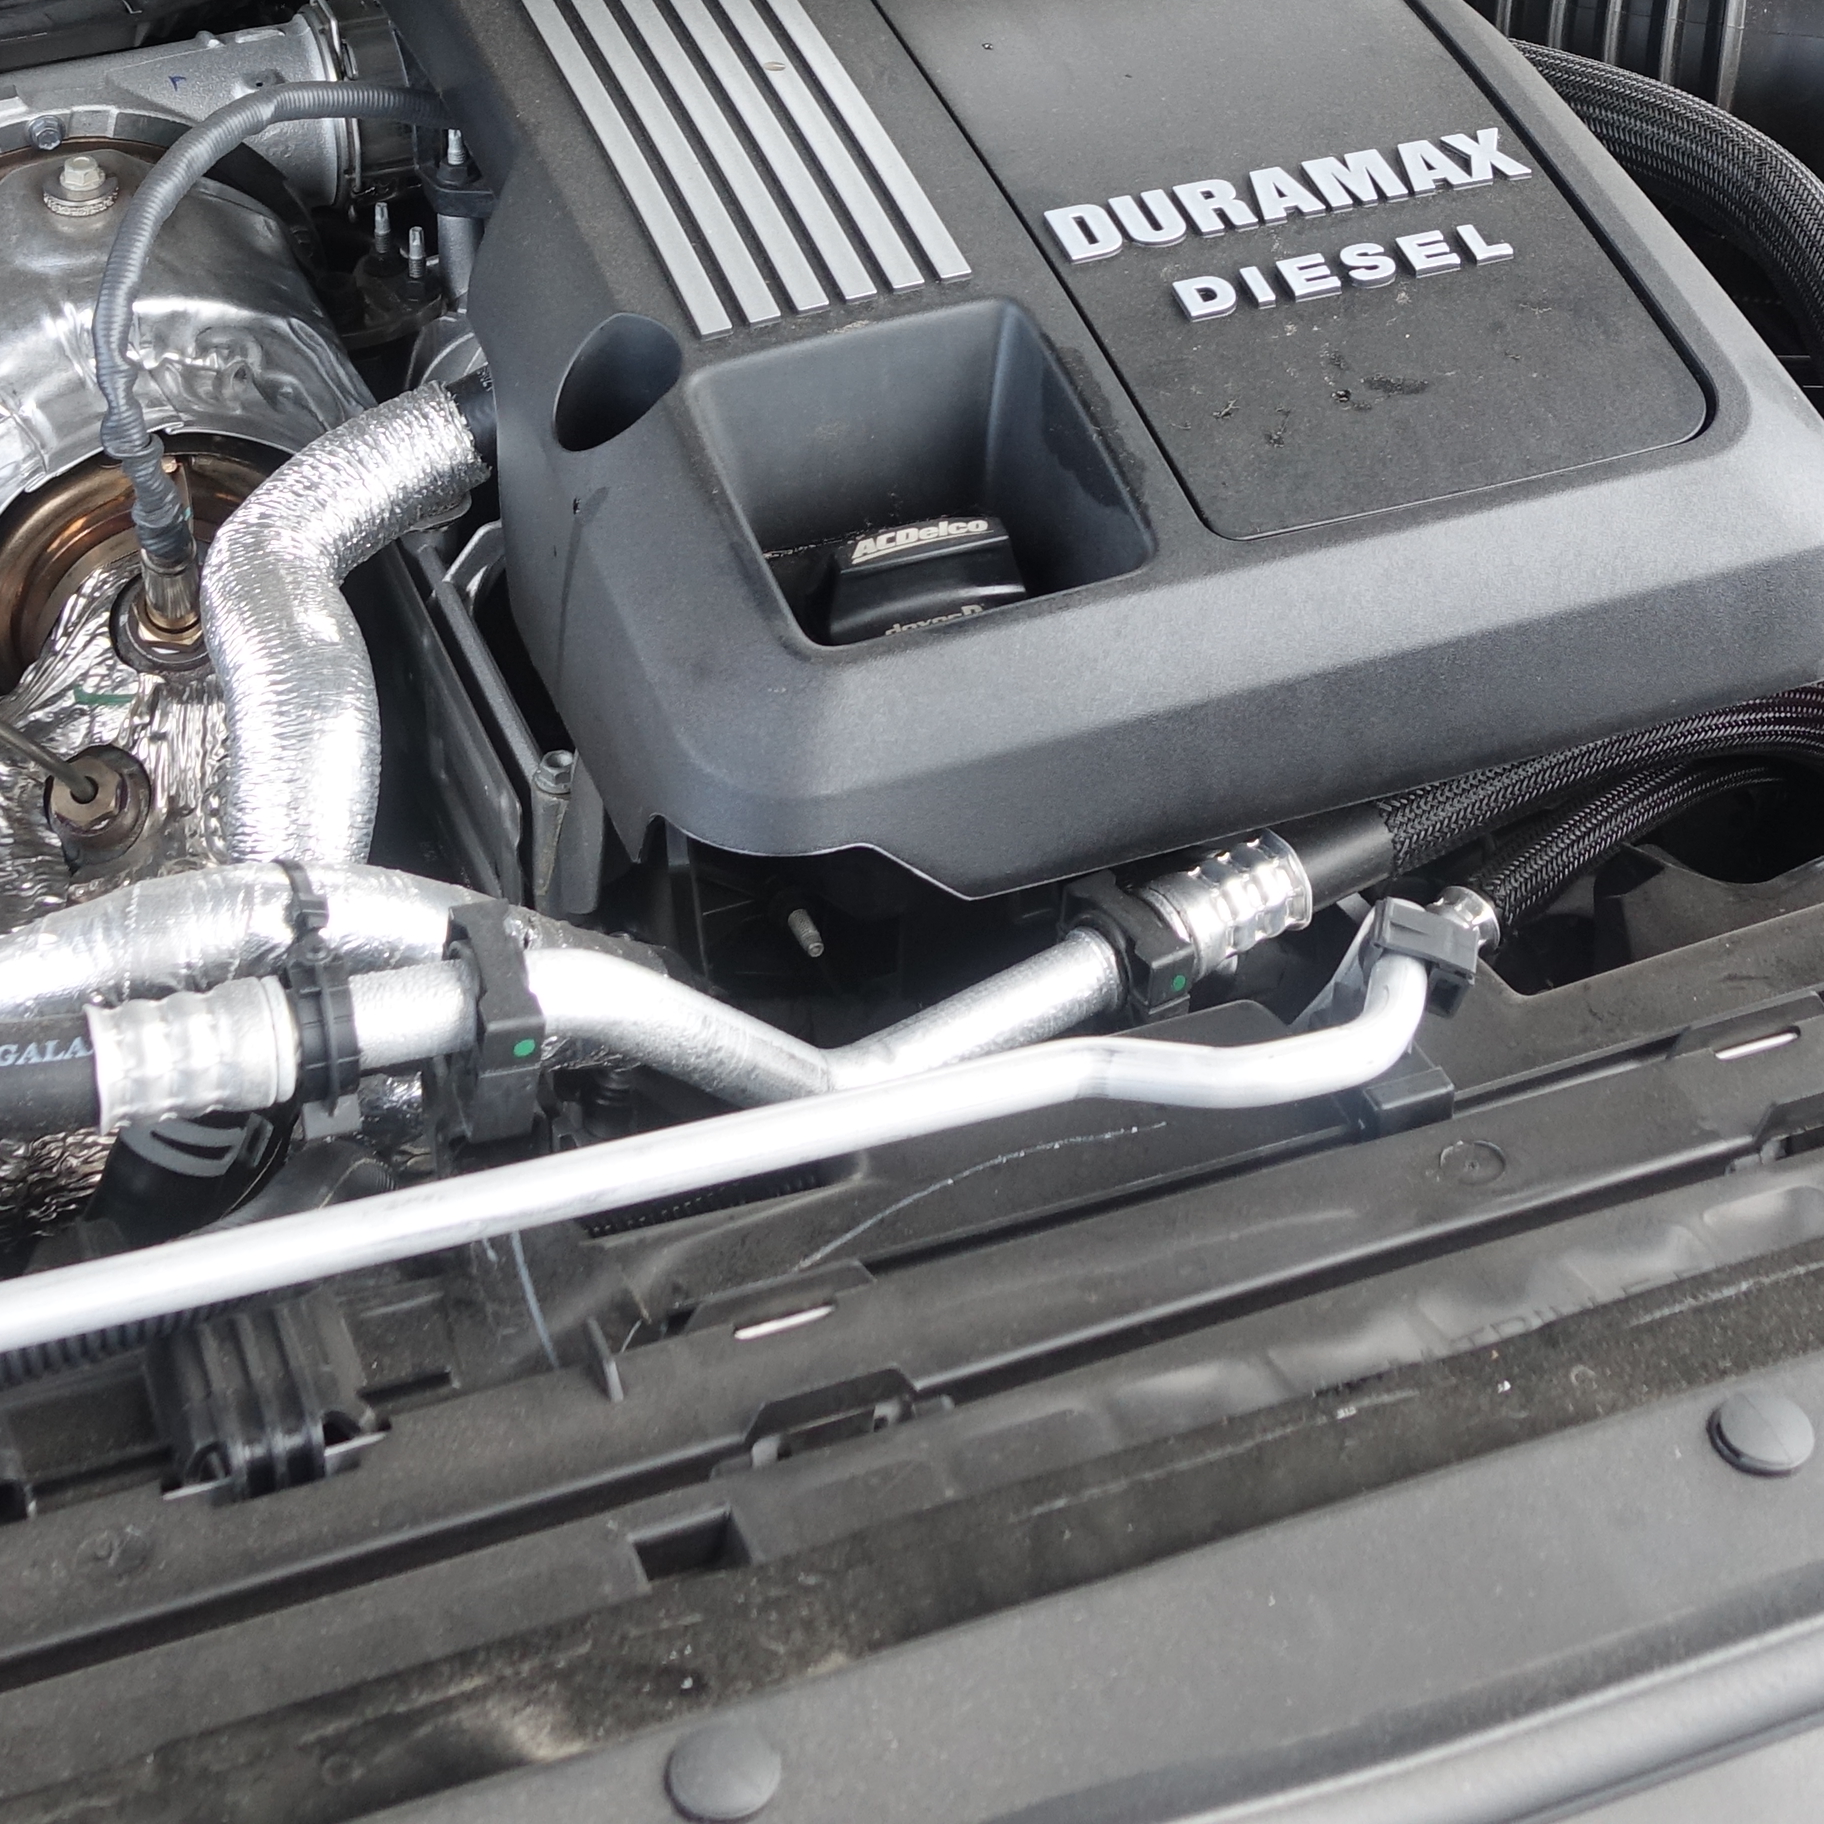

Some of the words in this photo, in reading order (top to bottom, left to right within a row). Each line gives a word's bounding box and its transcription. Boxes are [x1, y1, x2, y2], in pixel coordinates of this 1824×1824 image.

[1044, 126, 1532, 265] DURAMAX
[1172, 223, 1515, 322] DIESEL
[851, 519, 989, 560] ACDelco
